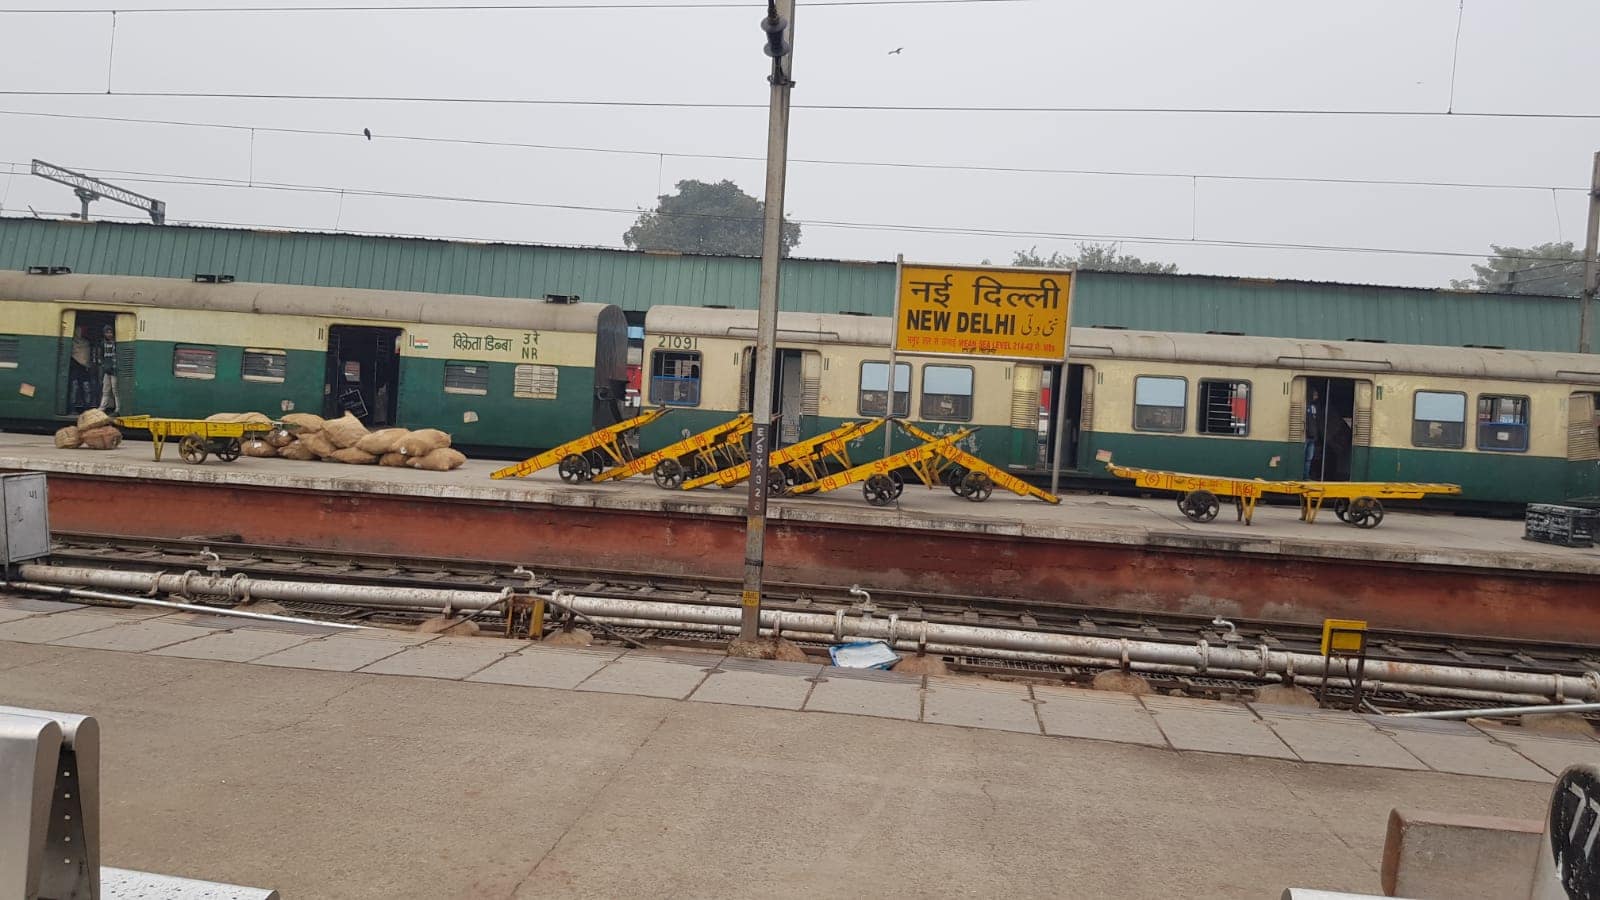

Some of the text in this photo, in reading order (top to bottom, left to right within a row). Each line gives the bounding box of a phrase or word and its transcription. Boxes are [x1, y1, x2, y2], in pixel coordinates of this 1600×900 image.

[909, 274, 1061, 309] नई दिल्ली
[907, 309, 1016, 335] NEW DELHI
[484, 335, 514, 352] डिब्बा
[658, 335, 698, 350] 21091
